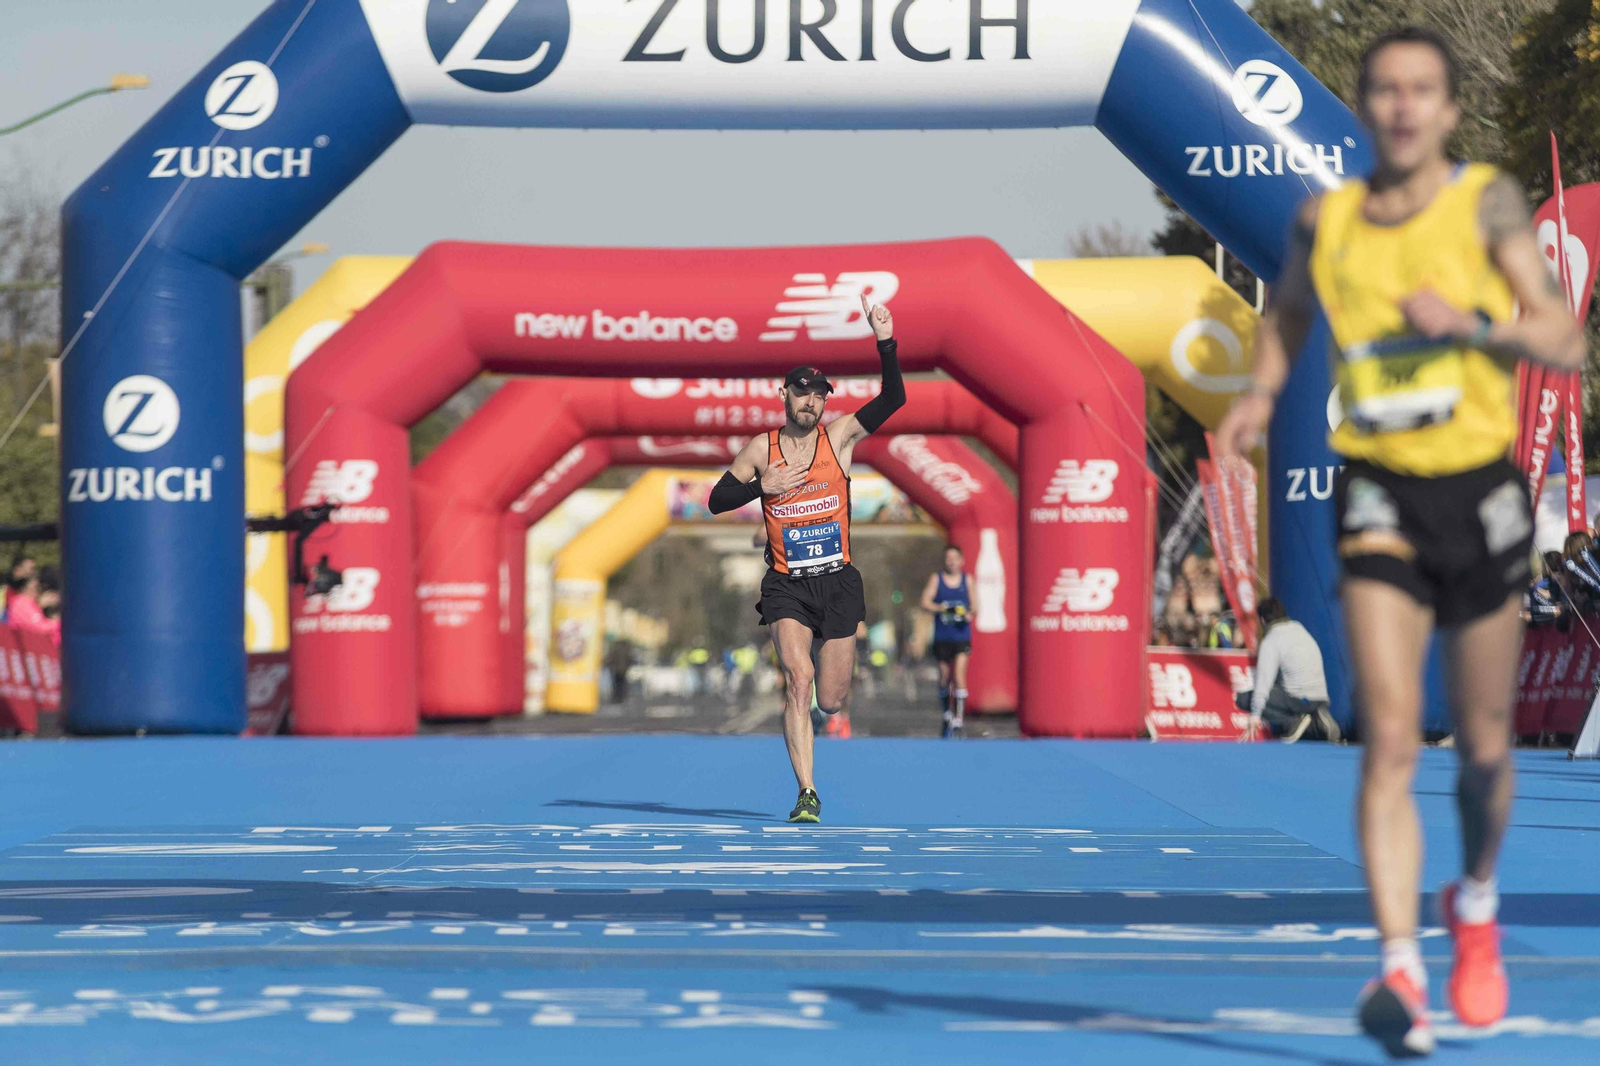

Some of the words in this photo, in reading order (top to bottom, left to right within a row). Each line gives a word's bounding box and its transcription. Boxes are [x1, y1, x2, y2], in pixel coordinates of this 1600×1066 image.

[622, 0, 1032, 64] ZURICH
[148, 146, 313, 179] ZURICH
[1184, 143, 1344, 178] ZURICH
[514, 312, 588, 339] new
[592, 309, 738, 342] balance
[68, 466, 212, 502] ZURICH
[774, 496, 838, 516] ostiliomobili
[1030, 508, 1060, 523] new
[1061, 504, 1129, 523] balance
[802, 526, 835, 538] ZURICH
[806, 544, 824, 557] 78
[1030, 615, 1060, 632] new
[1061, 612, 1129, 632] balance
